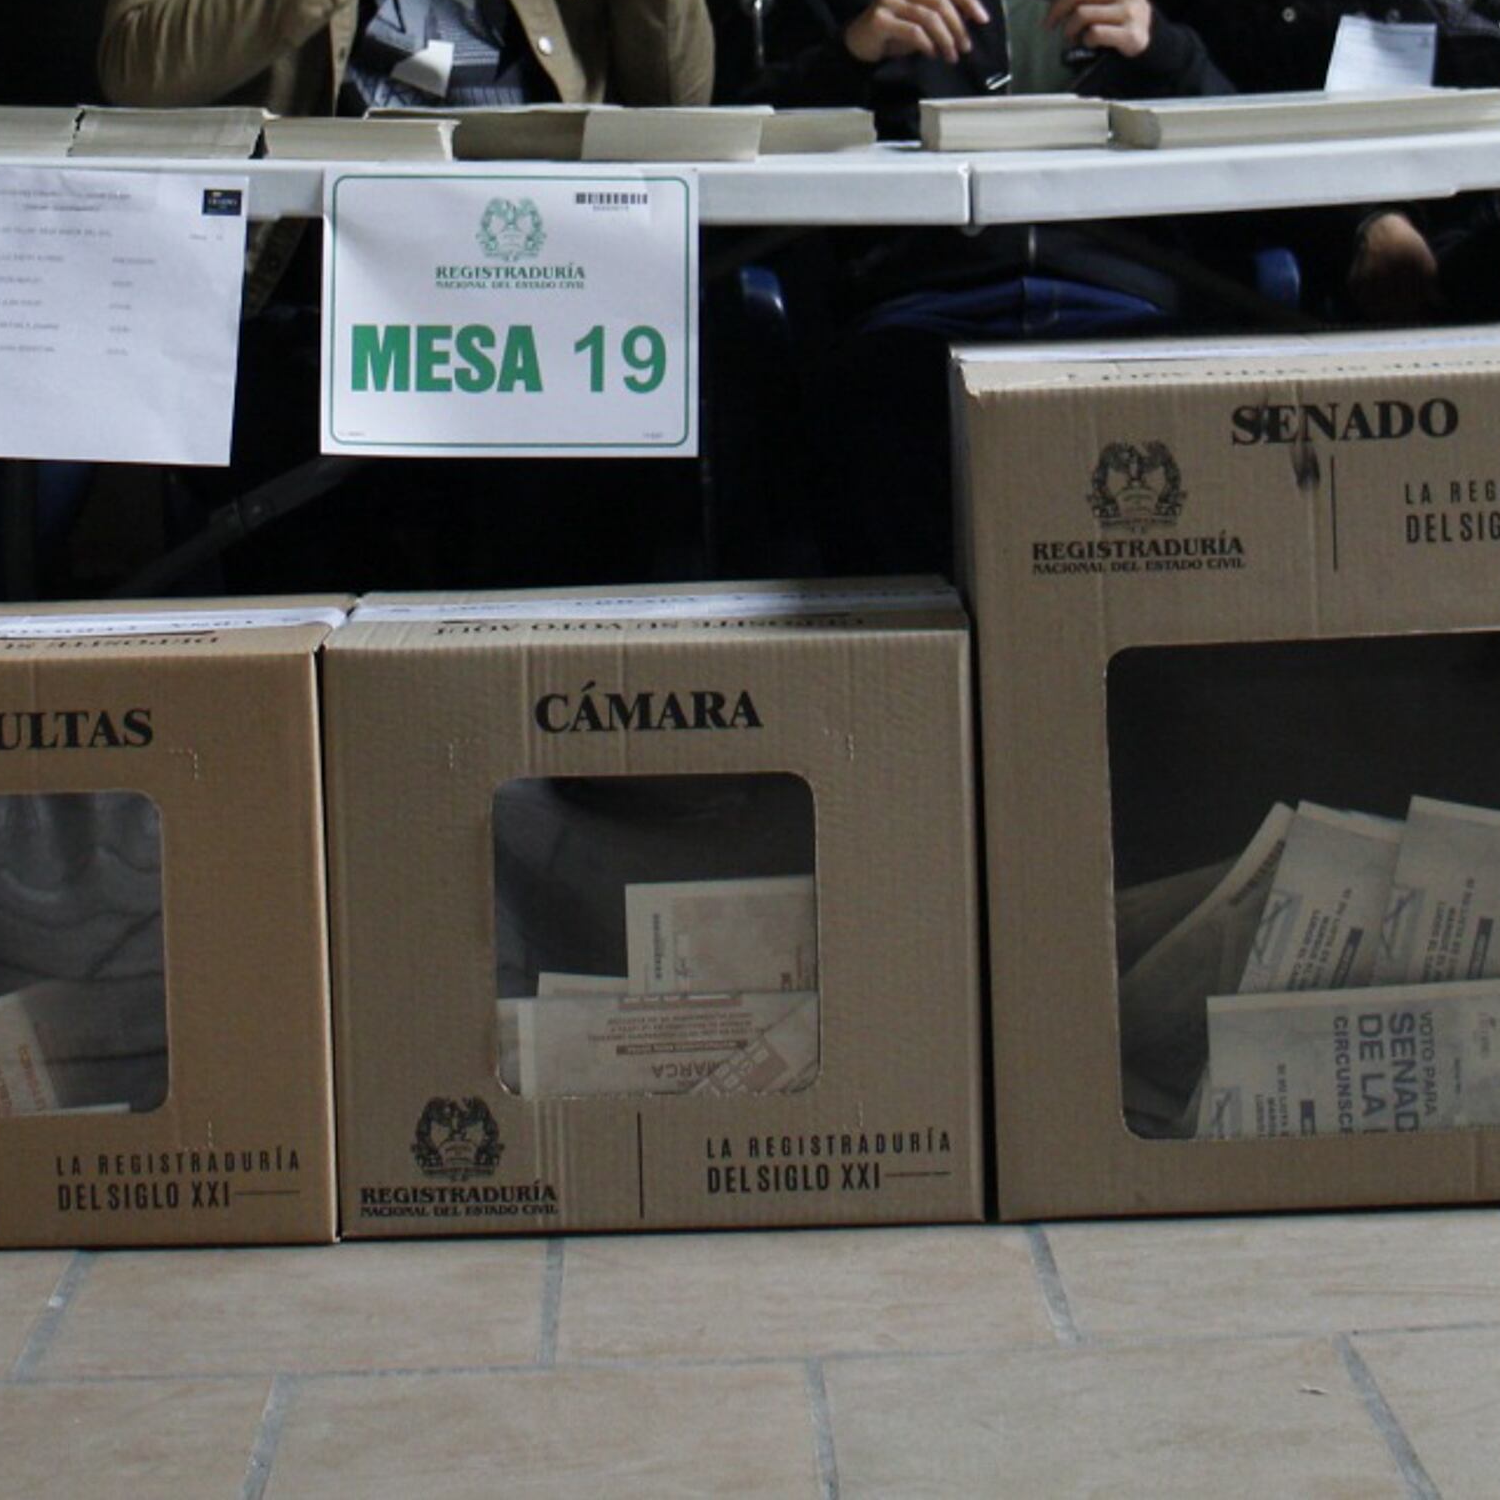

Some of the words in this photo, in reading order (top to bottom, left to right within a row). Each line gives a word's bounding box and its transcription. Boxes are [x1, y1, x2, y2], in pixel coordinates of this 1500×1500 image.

[435, 263, 585, 280] REGISTRADURÍA
[350, 324, 543, 393] MESA
[573, 324, 668, 394] 19
[1231, 397, 1459, 447] SENADO
[1404, 480, 1432, 505] LA
[1033, 529, 1244, 561] REGISTRADURÍA
[1033, 560, 1106, 575] NACIONAL
[1111, 559, 1140, 573] DEL
[1145, 559, 1202, 572] ESTADO
[1206, 557, 1245, 571] CIVIL
[532, 622, 623, 632] VOTO
[534, 679, 761, 733] CÁMARA
[1358, 1013, 1384, 1062] DE
[1419, 1011, 1435, 1062] VOTO
[1361, 1073, 1387, 1117] LA
[1421, 1065, 1436, 1117] PARA
[706, 1138, 732, 1159] LA
[749, 1127, 952, 1158] REGISTRADURÍA
[57, 1156, 81, 1175] LA
[98, 1146, 302, 1175] REGISTRADURÍA
[842, 1162, 880, 1191] XXI
[192, 1180, 230, 1208] XXI
[362, 1180, 558, 1204] REGISTRADURÍA
[362, 1205, 430, 1219] NACIONAL
[435, 1205, 461, 1218] DEL
[465, 1204, 518, 1218] ESTADO
[523, 1203, 559, 1216] CIVIL
